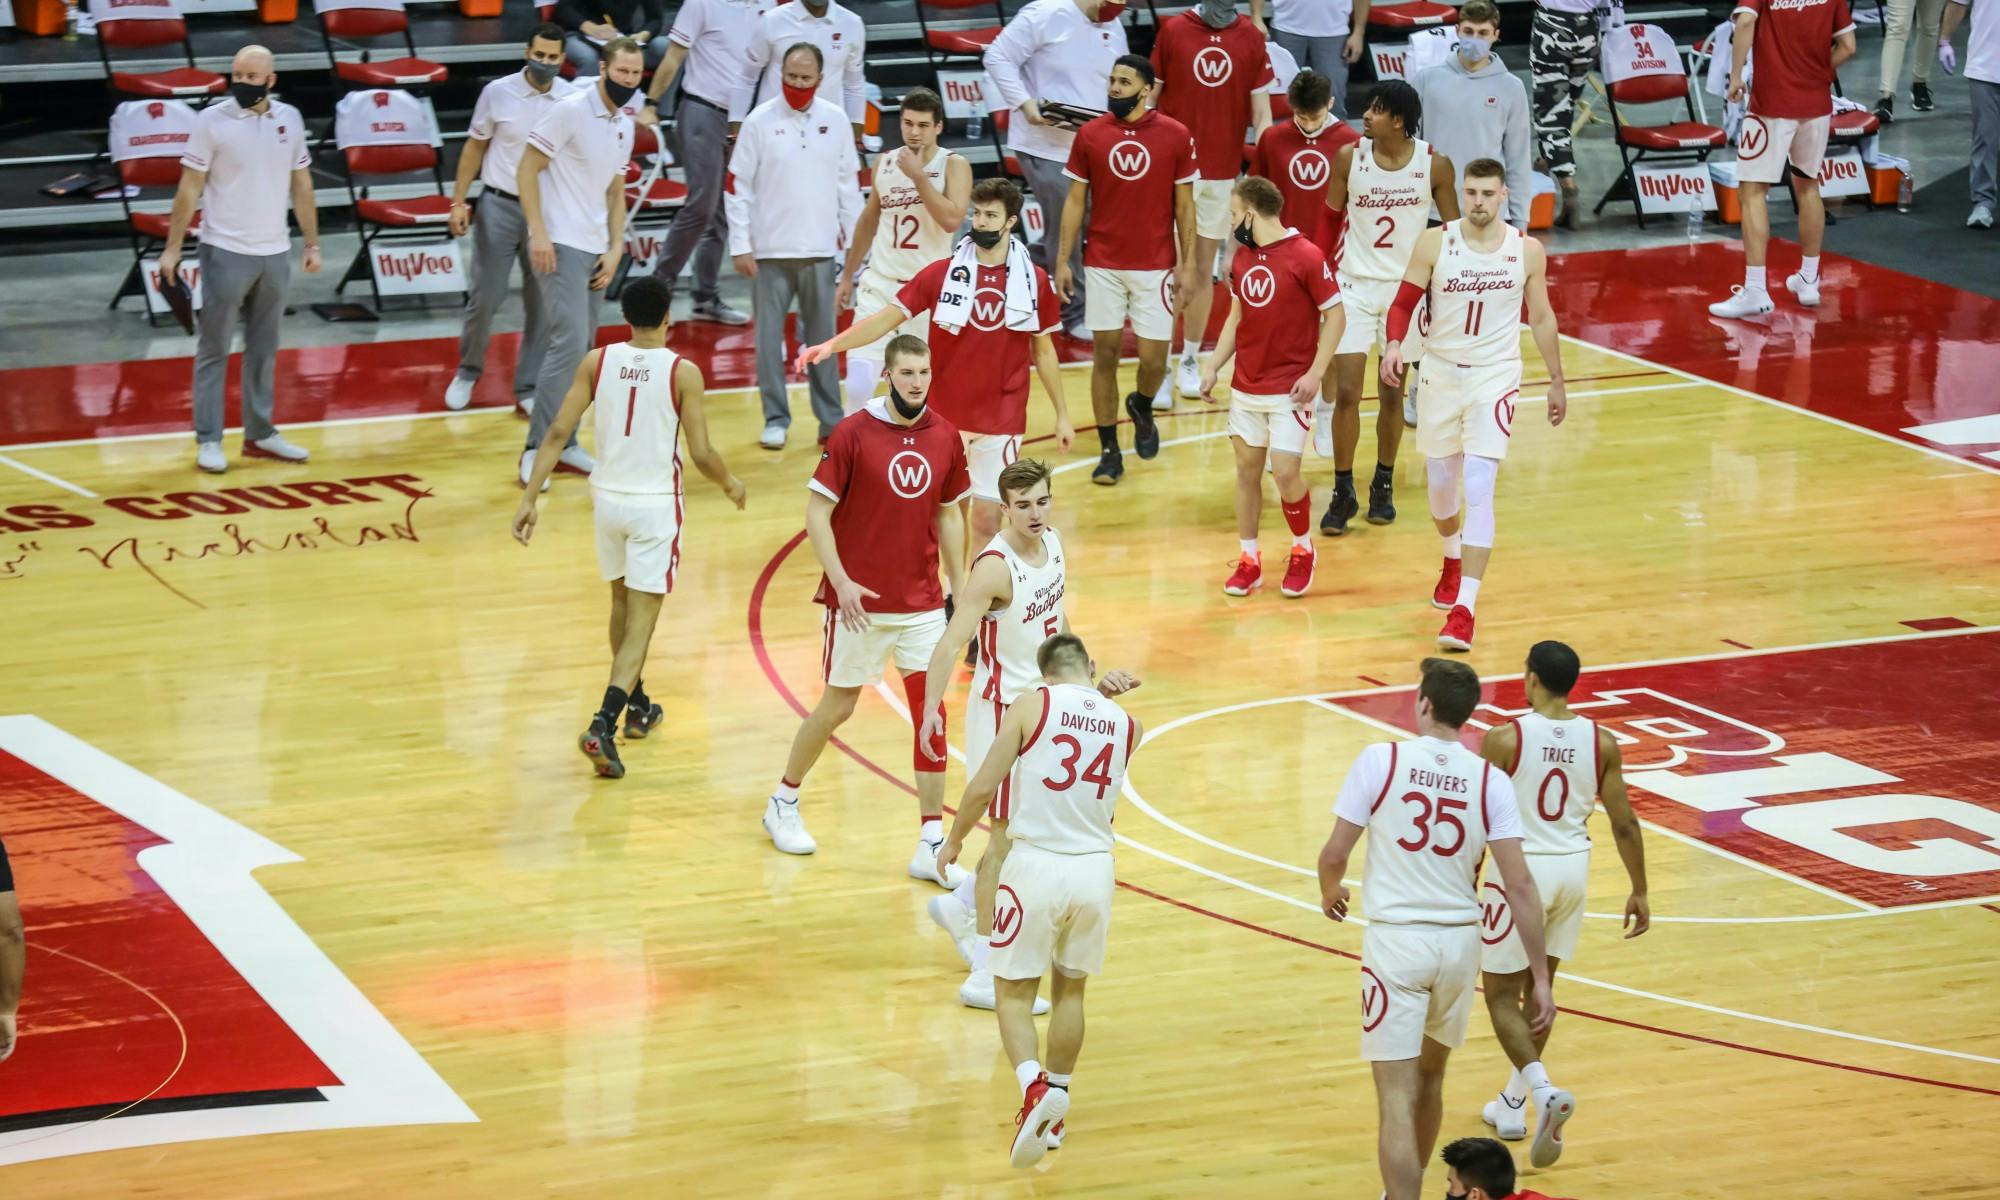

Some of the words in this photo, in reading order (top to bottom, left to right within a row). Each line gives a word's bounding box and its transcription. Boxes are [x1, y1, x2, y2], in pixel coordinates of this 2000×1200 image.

[1634, 42, 1654, 58] 34
[1631, 60, 1667, 71] DAVISON
[1817, 159, 1857, 187] Vee
[1640, 174, 1705, 202] HyVee
[880, 195, 922, 210] Badge
[1355, 194, 1421, 211] Badgers
[893, 214, 920, 250] 12
[1374, 216, 1395, 248] 2
[378, 252, 453, 282] HyVee
[1323, 261, 1334, 282] 4
[1460, 269, 1509, 278] Wisconsin
[939, 292, 962, 307] DE
[1443, 278, 1515, 295] Badgers
[1464, 301, 1484, 337] 11
[620, 366, 651, 382] DAVIS
[624, 386, 637, 437] 1
[103, 474, 434, 520] COURT
[1061, 711, 1116, 737] DAVISON
[1042, 733, 1114, 800] 34
[1542, 746, 1576, 763] TRICE
[1409, 768, 1468, 794] REUVERS
[1537, 767, 1569, 821] 0
[1397, 791, 1468, 857] 35
[1904, 879, 1937, 892] TM
